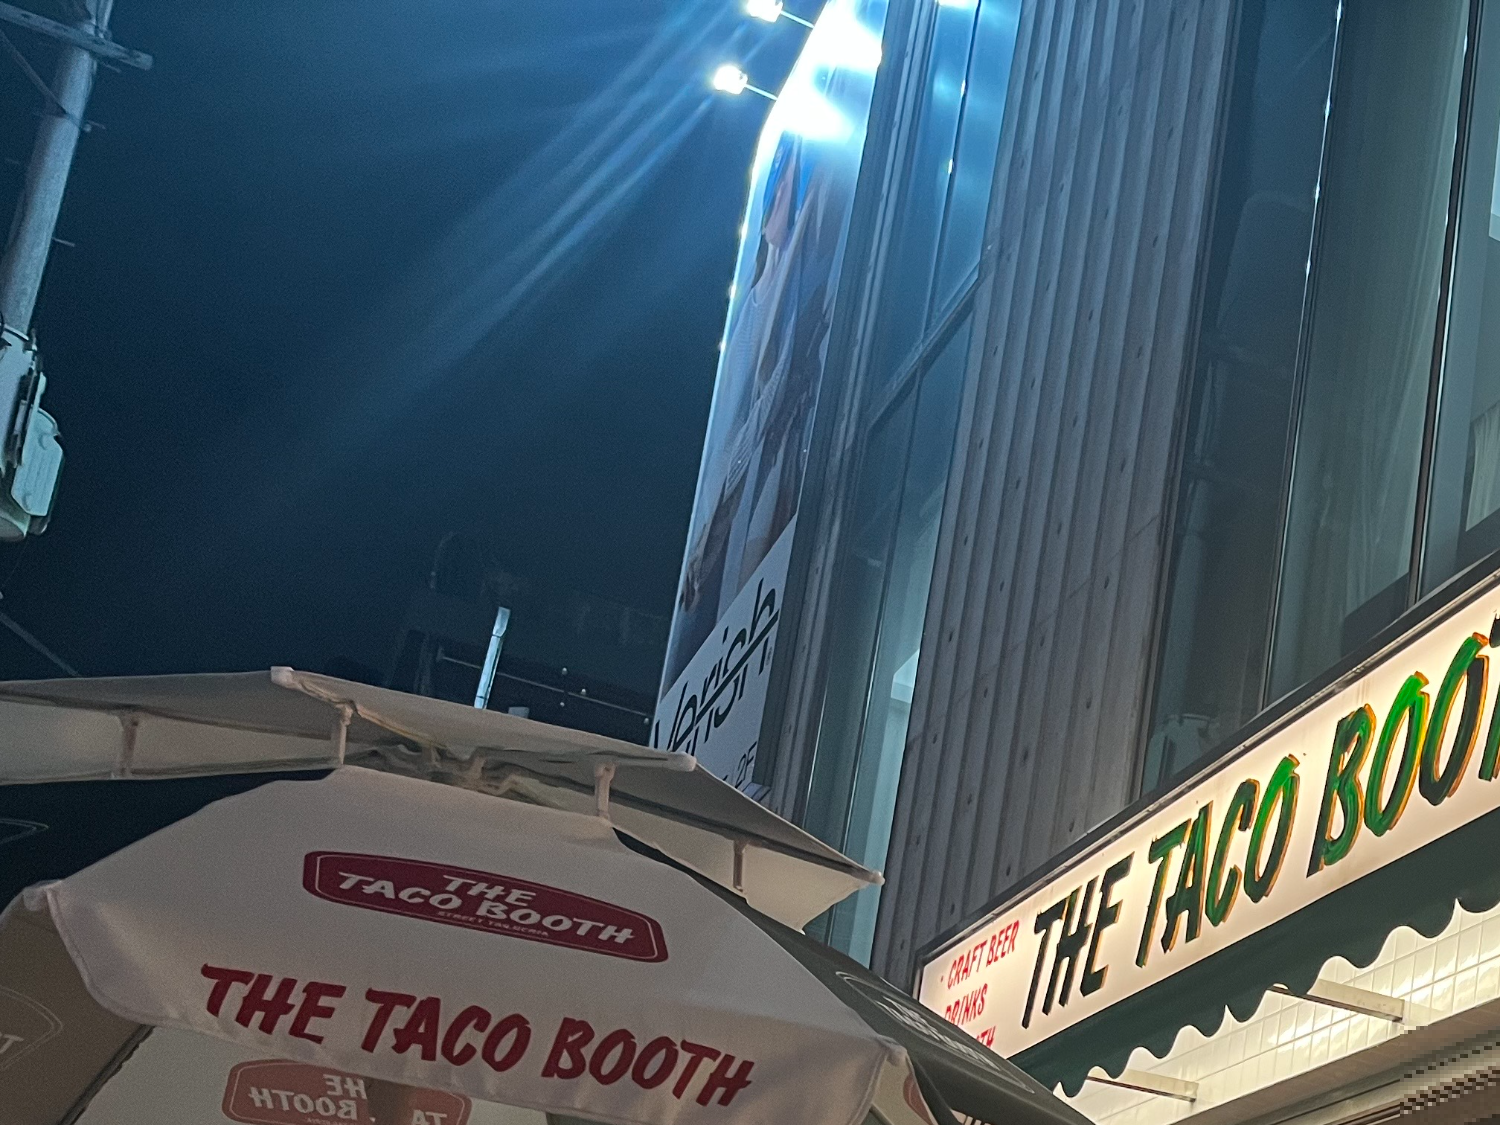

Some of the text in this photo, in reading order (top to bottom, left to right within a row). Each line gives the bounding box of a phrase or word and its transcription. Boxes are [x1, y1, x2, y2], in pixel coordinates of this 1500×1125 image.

[338, 871, 636, 944] TACO BOOTH
[442, 874, 536, 906] THE
[1021, 851, 1135, 1030] THE
[1135, 754, 1300, 968] TACO
[948, 920, 1020, 990] CRAFT BEER
[200, 963, 755, 1107] THE TACO BOOTH
